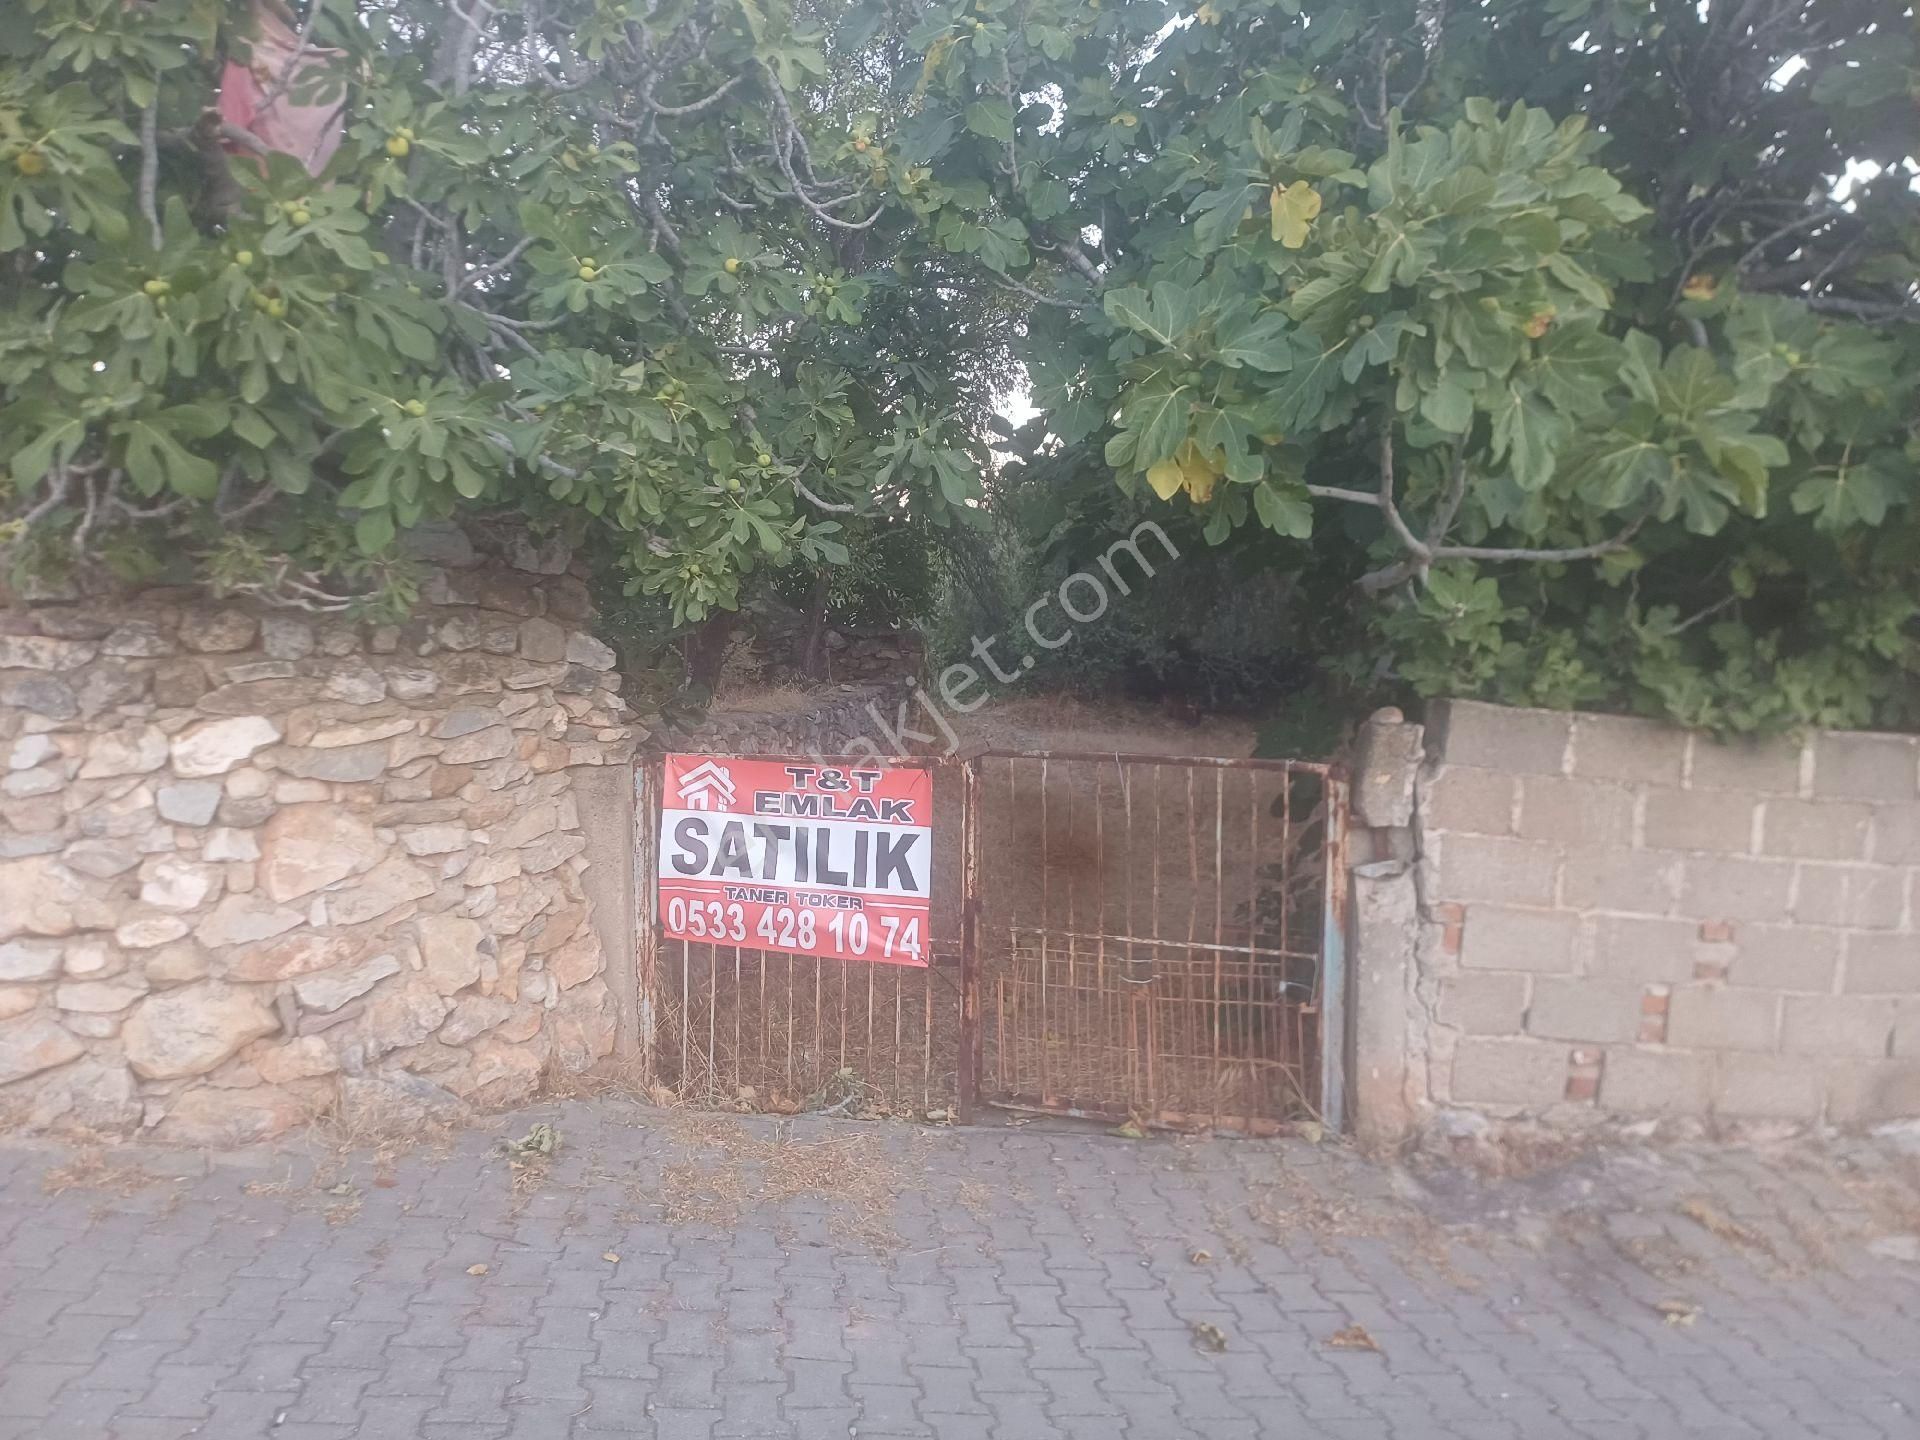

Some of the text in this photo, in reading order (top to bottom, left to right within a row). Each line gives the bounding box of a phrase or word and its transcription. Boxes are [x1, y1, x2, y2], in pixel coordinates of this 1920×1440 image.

[786, 767, 882, 793] T&T
[754, 791, 915, 823] EMLAK
[671, 817, 921, 891] SATILIK
[724, 886, 864, 910] TANER TOKER
[668, 896, 922, 961] 0533 428 10 74
